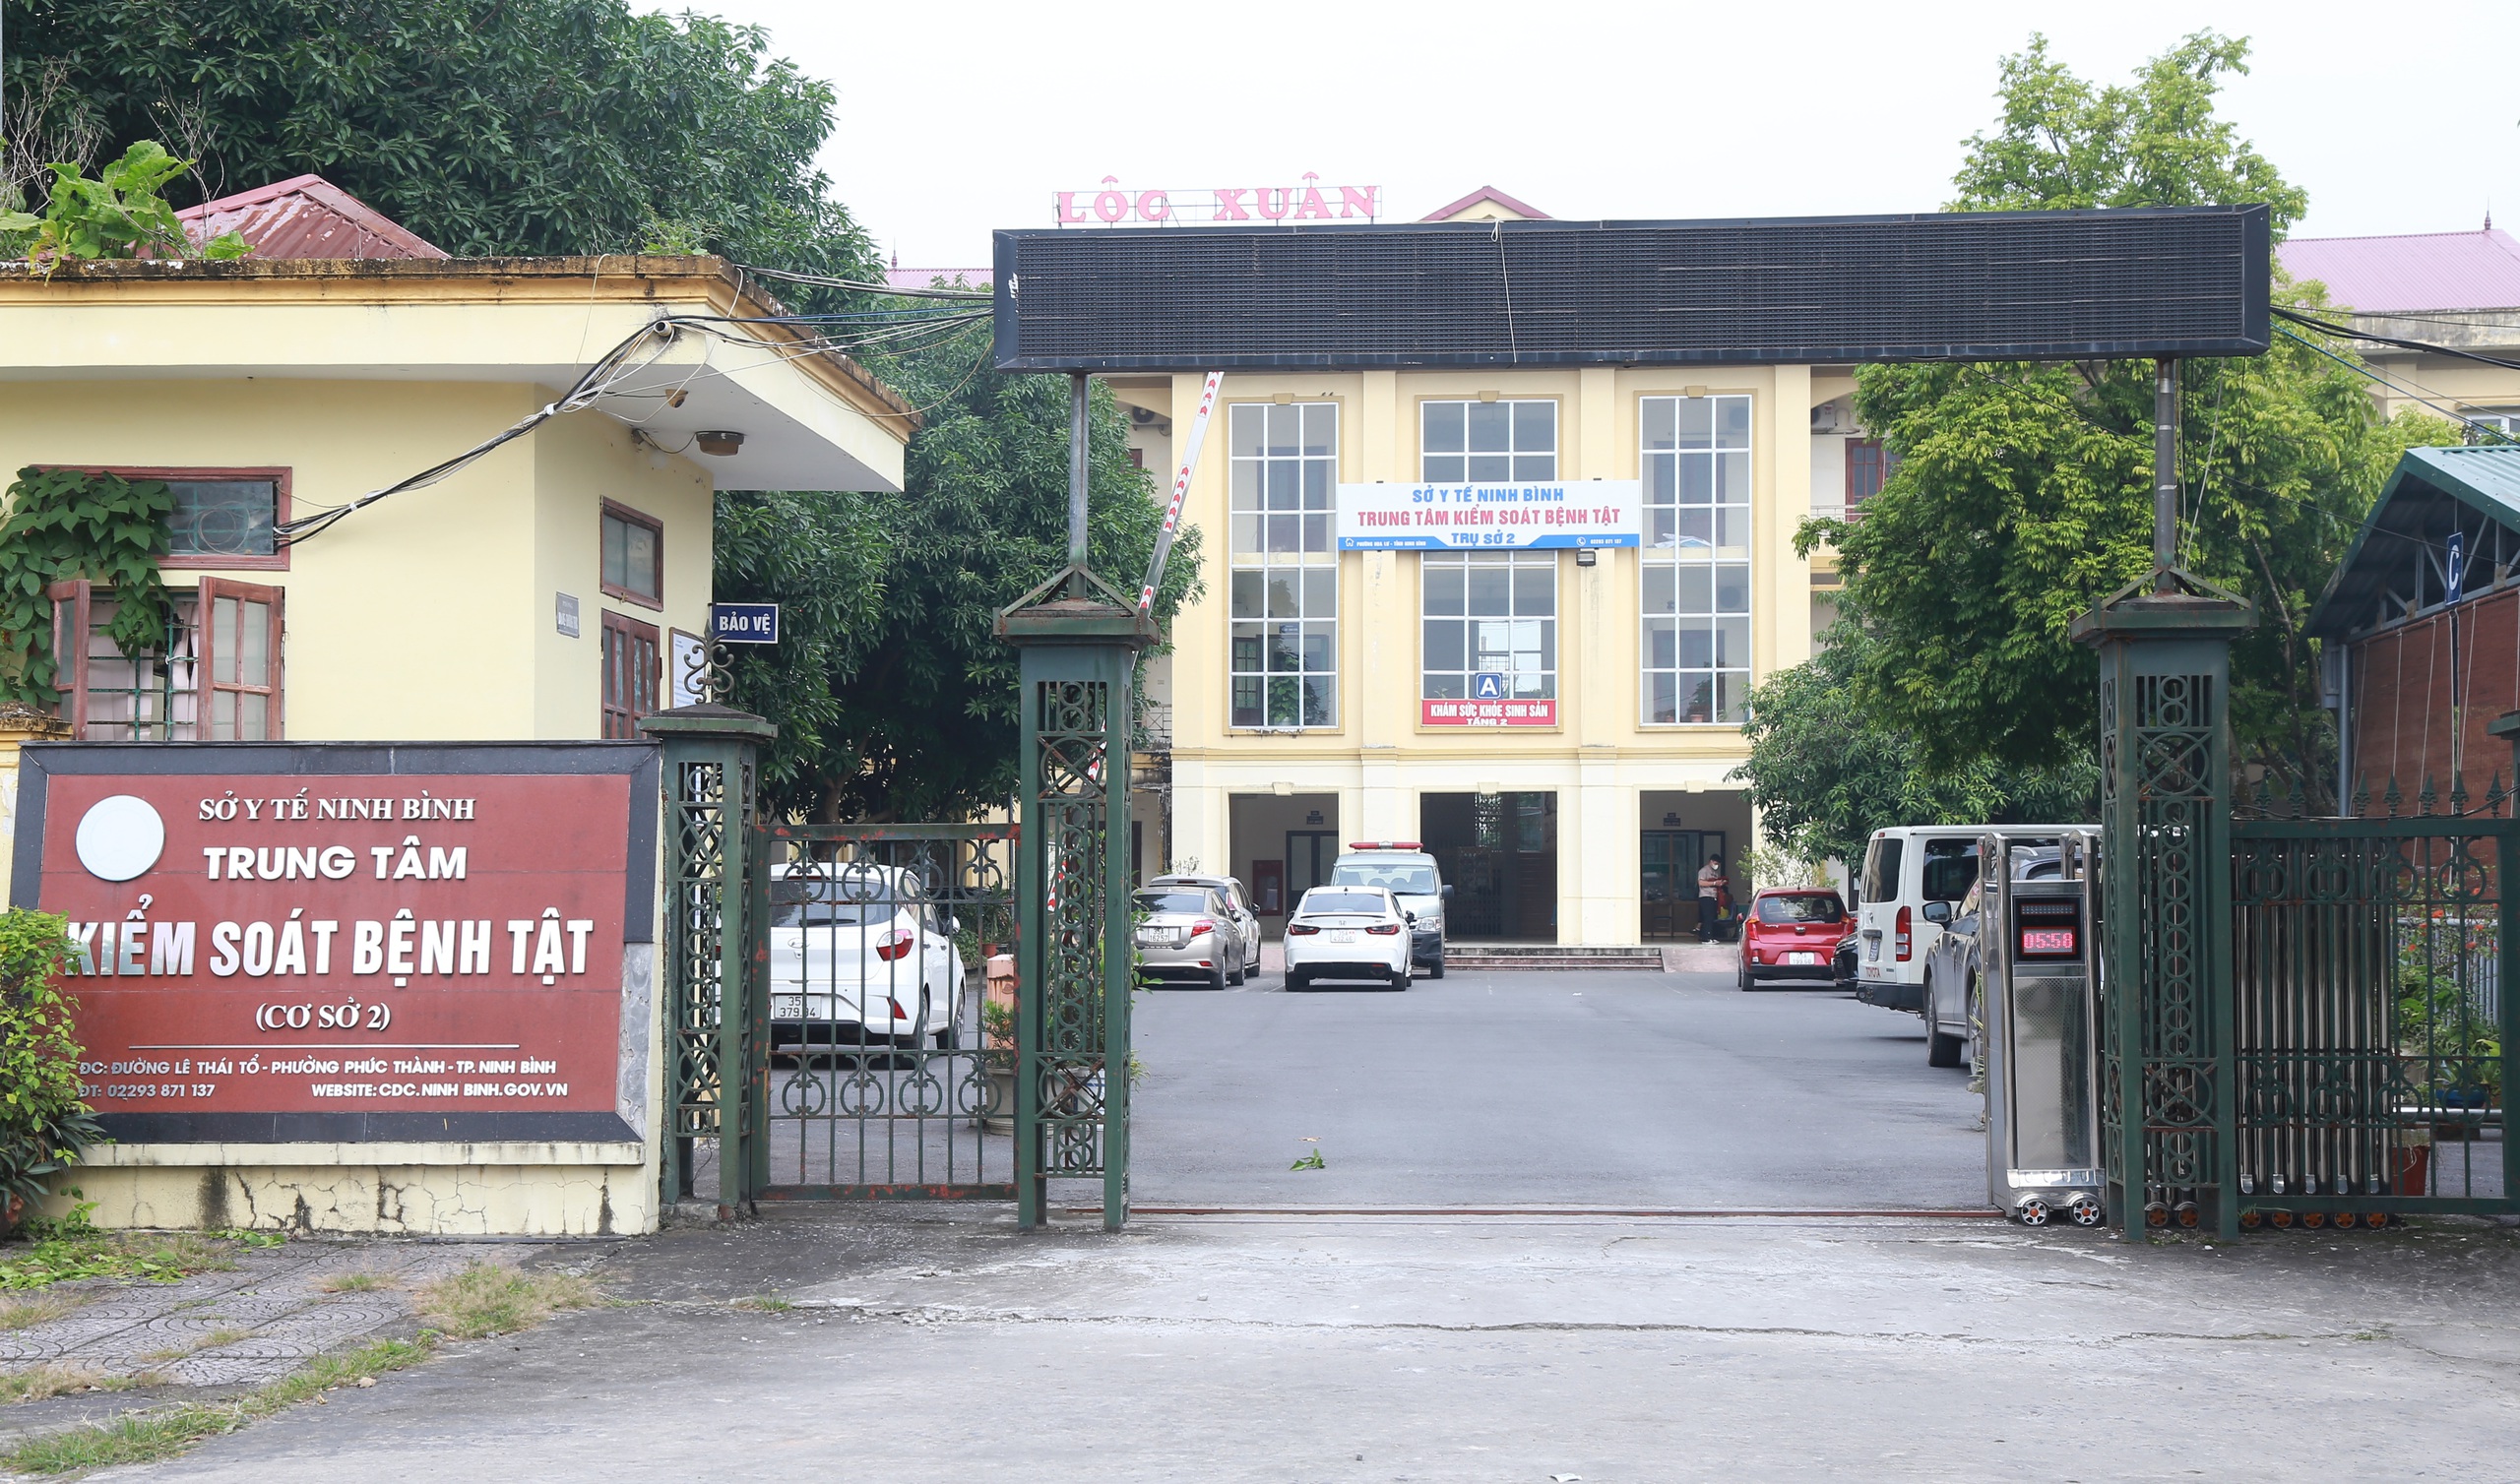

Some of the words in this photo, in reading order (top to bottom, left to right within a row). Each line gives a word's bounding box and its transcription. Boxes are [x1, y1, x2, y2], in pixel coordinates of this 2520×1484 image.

[1213, 171, 1376, 220] XUÂN
[1413, 484, 1434, 503] SỞ
[1439, 489, 1449, 503] Y
[1454, 485, 1473, 503] TẾ
[1478, 488, 1518, 502] NINH
[1523, 485, 1564, 502] BÌNH
[1357, 510, 1411, 526] TRUNG
[1415, 508, 1449, 526] TÂM
[1453, 503, 1494, 526] KIỂM
[1498, 506, 1541, 525] SOÁT
[1544, 506, 1588, 526] BỆNH
[1592, 505, 1620, 526] TẬT
[1451, 532, 1480, 547] TRỤ
[1483, 528, 1503, 544] SỞ
[1506, 532, 1516, 544] 2
[2449, 544, 2460, 590] C
[719, 611, 749, 632] BẢO
[752, 613, 772, 635] VỆ
[1480, 677, 1498, 696] A
[1430, 702, 1457, 717] KHÁM
[1459, 702, 1478, 717] SỨC
[1479, 700, 1503, 717] KHỎE
[1505, 705, 1527, 717] SINH
[1529, 701, 1548, 717] SẢN
[198, 790, 239, 821] SỞ
[243, 798, 263, 821] Y
[271, 787, 309, 821] TẾ
[316, 798, 394, 821] NINH
[401, 790, 476, 821] BÌNH
[203, 845, 356, 881] TRUNG
[370, 835, 468, 880] TÂM
[64, 894, 196, 976] KIỂM
[209, 907, 339, 976] SOÁT
[352, 908, 491, 987] BỆNH
[507, 906, 594, 985] TẬT
[2024, 933, 2073, 949] 05:58
[255, 1002, 312, 1032] (CƠ
[318, 995, 361, 1029] SỞ
[366, 1001, 391, 1031] 2)
[78, 1061, 107, 1075] ĐC:
[111, 1057, 170, 1075] ĐƯỜNG
[174, 1058, 190, 1075] LÊ
[197, 1057, 233, 1075] THÁI
[239, 1053, 260, 1075] TỔ
[271, 1054, 340, 1075] PHƯỜNG
[345, 1057, 388, 1074] PHÚC
[393, 1056, 445, 1074] THÀNH
[456, 1061, 475, 1074] TP.
[478, 1061, 515, 1074] NINH
[520, 1056, 556, 1074] BÌNH
[79, 1084, 101, 1097] ĐT:
[107, 1084, 157, 1097] 02293
[160, 1084, 185, 1097] 871
[191, 1084, 216, 1097] 137
